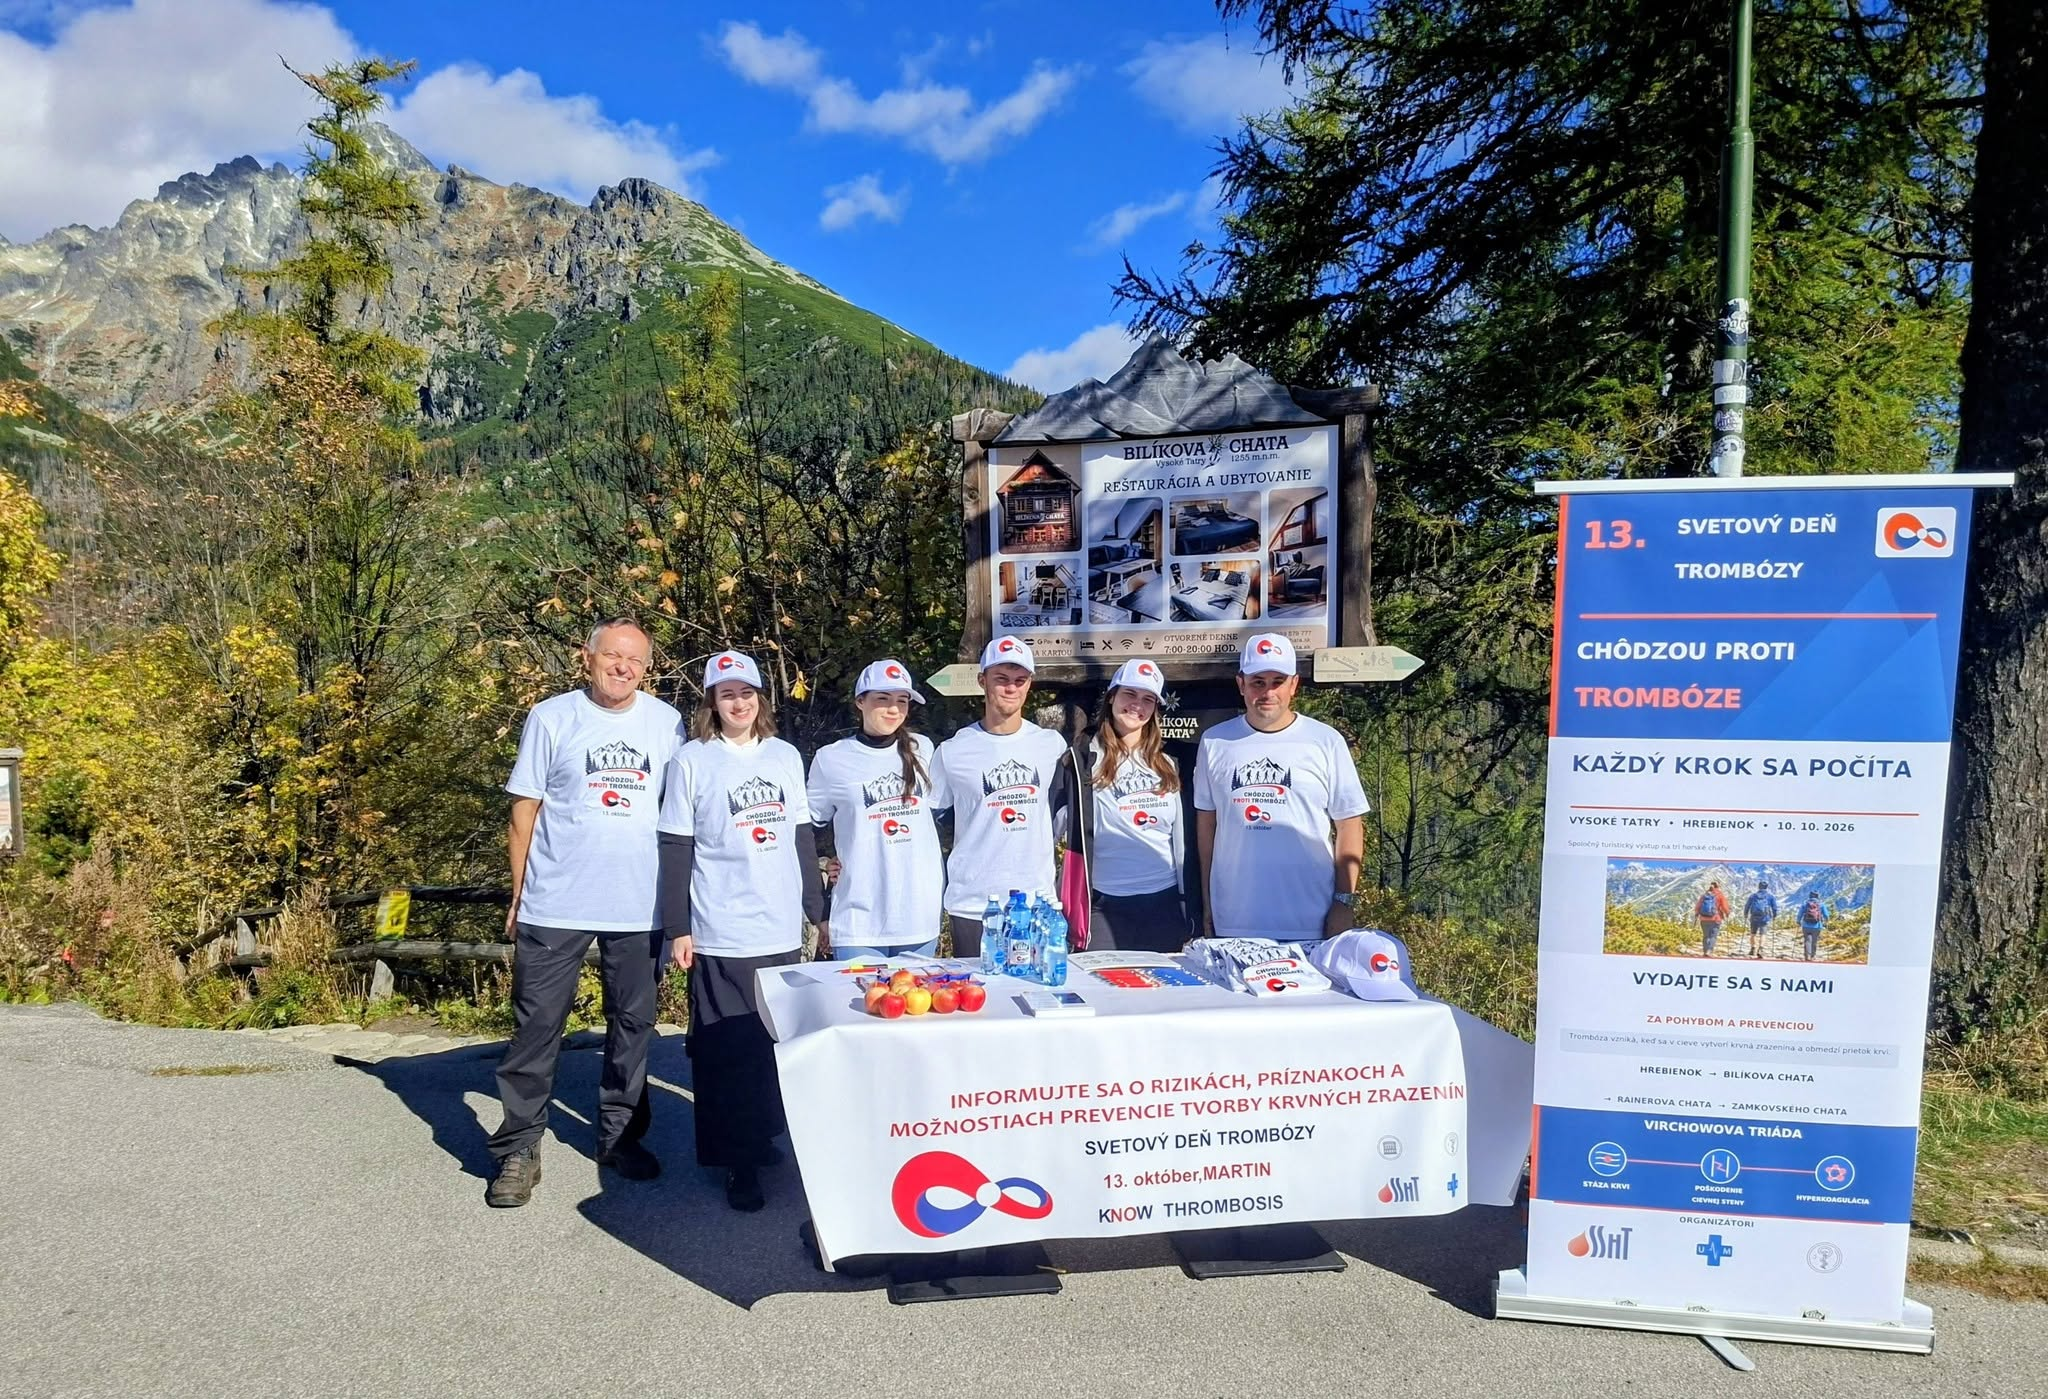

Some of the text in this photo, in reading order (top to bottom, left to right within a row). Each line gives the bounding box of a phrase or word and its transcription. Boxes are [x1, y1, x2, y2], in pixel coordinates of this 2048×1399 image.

[1123, 435, 1289, 460] BILÍKOVA CHATA
[1155, 458, 1206, 469] Vysoké Tatry
[1231, 454, 1250, 463] 1255
[1205, 476, 1215, 486] A
[1220, 469, 1312, 486] UBYTOVANIE
[1678, 513, 1837, 535] SVETOVÝ DEŇ
[1584, 521, 1645, 549] 13.
[1674, 559, 1804, 579] TROMBÓZY
[1163, 633, 1238, 642] OTVORENÉ DENNE
[1163, 644, 1238, 654] 7:00-20:00 HOD.
[1577, 638, 1795, 661] CHÔDZOU PROTI
[1574, 683, 1742, 709] TROMBÓZE
[1573, 751, 1912, 779] KAŽDÝ KROK SA POČÍTA
[609, 783, 646, 791] TROMBÓZE
[1569, 816, 1855, 832] VYSOKÉ TATRY HREBIENOK 10. 10. 2026
[1568, 840, 1599, 848] Spoločný
[1601, 841, 1634, 850] turistický
[1636, 842, 1660, 850] výstup
[1633, 972, 1834, 994] VYDAJTE SA S NAMI
[1647, 1015, 1814, 1031] ZA POHYBOM A PREVENCIOU
[1569, 1032, 1608, 1042] Trombóza
[1641, 1036, 1656, 1044] keď
[1731, 1041, 1754, 1050] krvná
[1756, 1043, 1795, 1052] zrazenina
[1842, 1046, 1871, 1055] prietok
[1640, 1066, 1814, 1082] HREBIENOK BILÍKOVA CHATA
[951, 1063, 1405, 1109] INFORMUJTE SA O RIZIKÁCH, PRÍZNAKOCH A
[890, 1082, 1464, 1138] MOŽNOSTIACH PREVENCIE TVORBY KRVNÝCH ZRAZENÍN
[1617, 1095, 1847, 1116] RAINEROVA CHATA ZAMKOVSKÉHO CHATA
[1644, 1120, 1802, 1139] VIRCHOWOVA TRIÁDA
[1085, 1123, 1316, 1155] SVETOVÝ DEŇ TROMBÓZY
[1103, 1174, 1128, 1189] 13.
[1583, 1180, 1630, 1190] STÁZA KRVI
[1695, 1184, 1743, 1194] POŠKODENIE
[1691, 1196, 1719, 1205] CIEVNEJ
[1796, 1194, 1870, 1205] HYPERKOAGULÁCIA
[1099, 1195, 1284, 1223] KNOW THROMBOSIS
[1679, 1216, 1754, 1228] ORGANIZÁTORI
